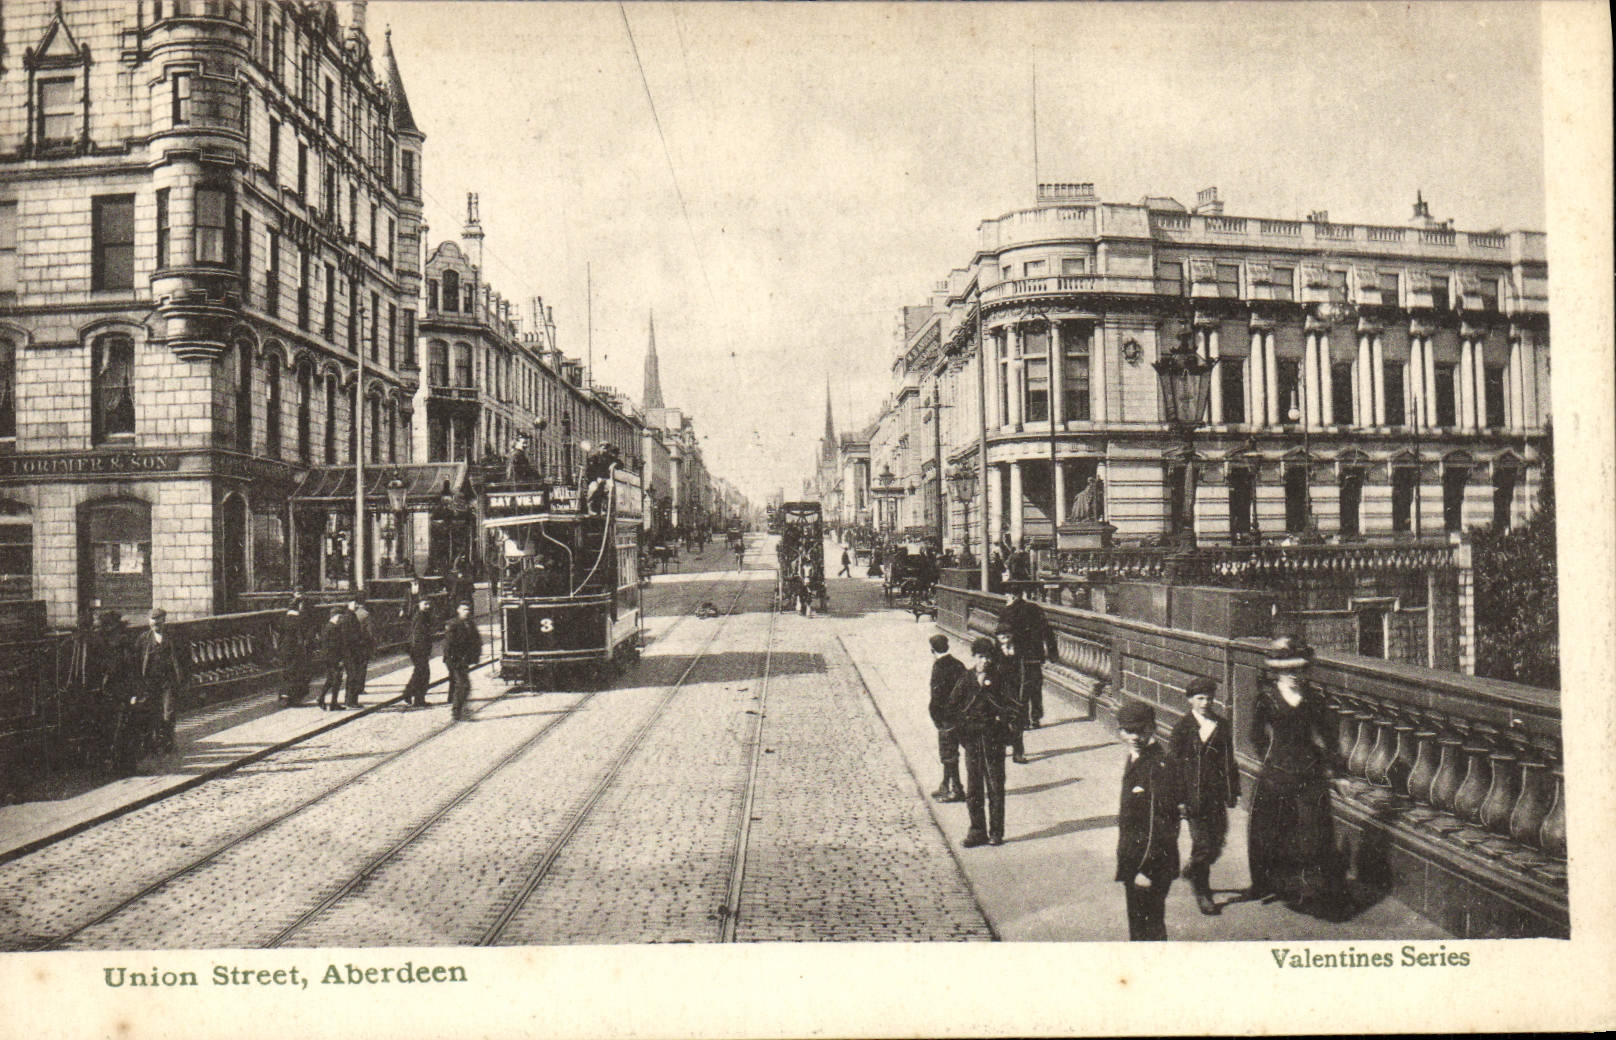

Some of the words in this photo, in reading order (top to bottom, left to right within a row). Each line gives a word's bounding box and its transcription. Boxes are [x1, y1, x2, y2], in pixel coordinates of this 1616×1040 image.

[111, 455, 124, 468] &
[131, 454, 168, 470] SON
[490, 496, 511, 507] BAY
[516, 495, 541, 506] VIEW
[540, 618, 554, 633] 3
